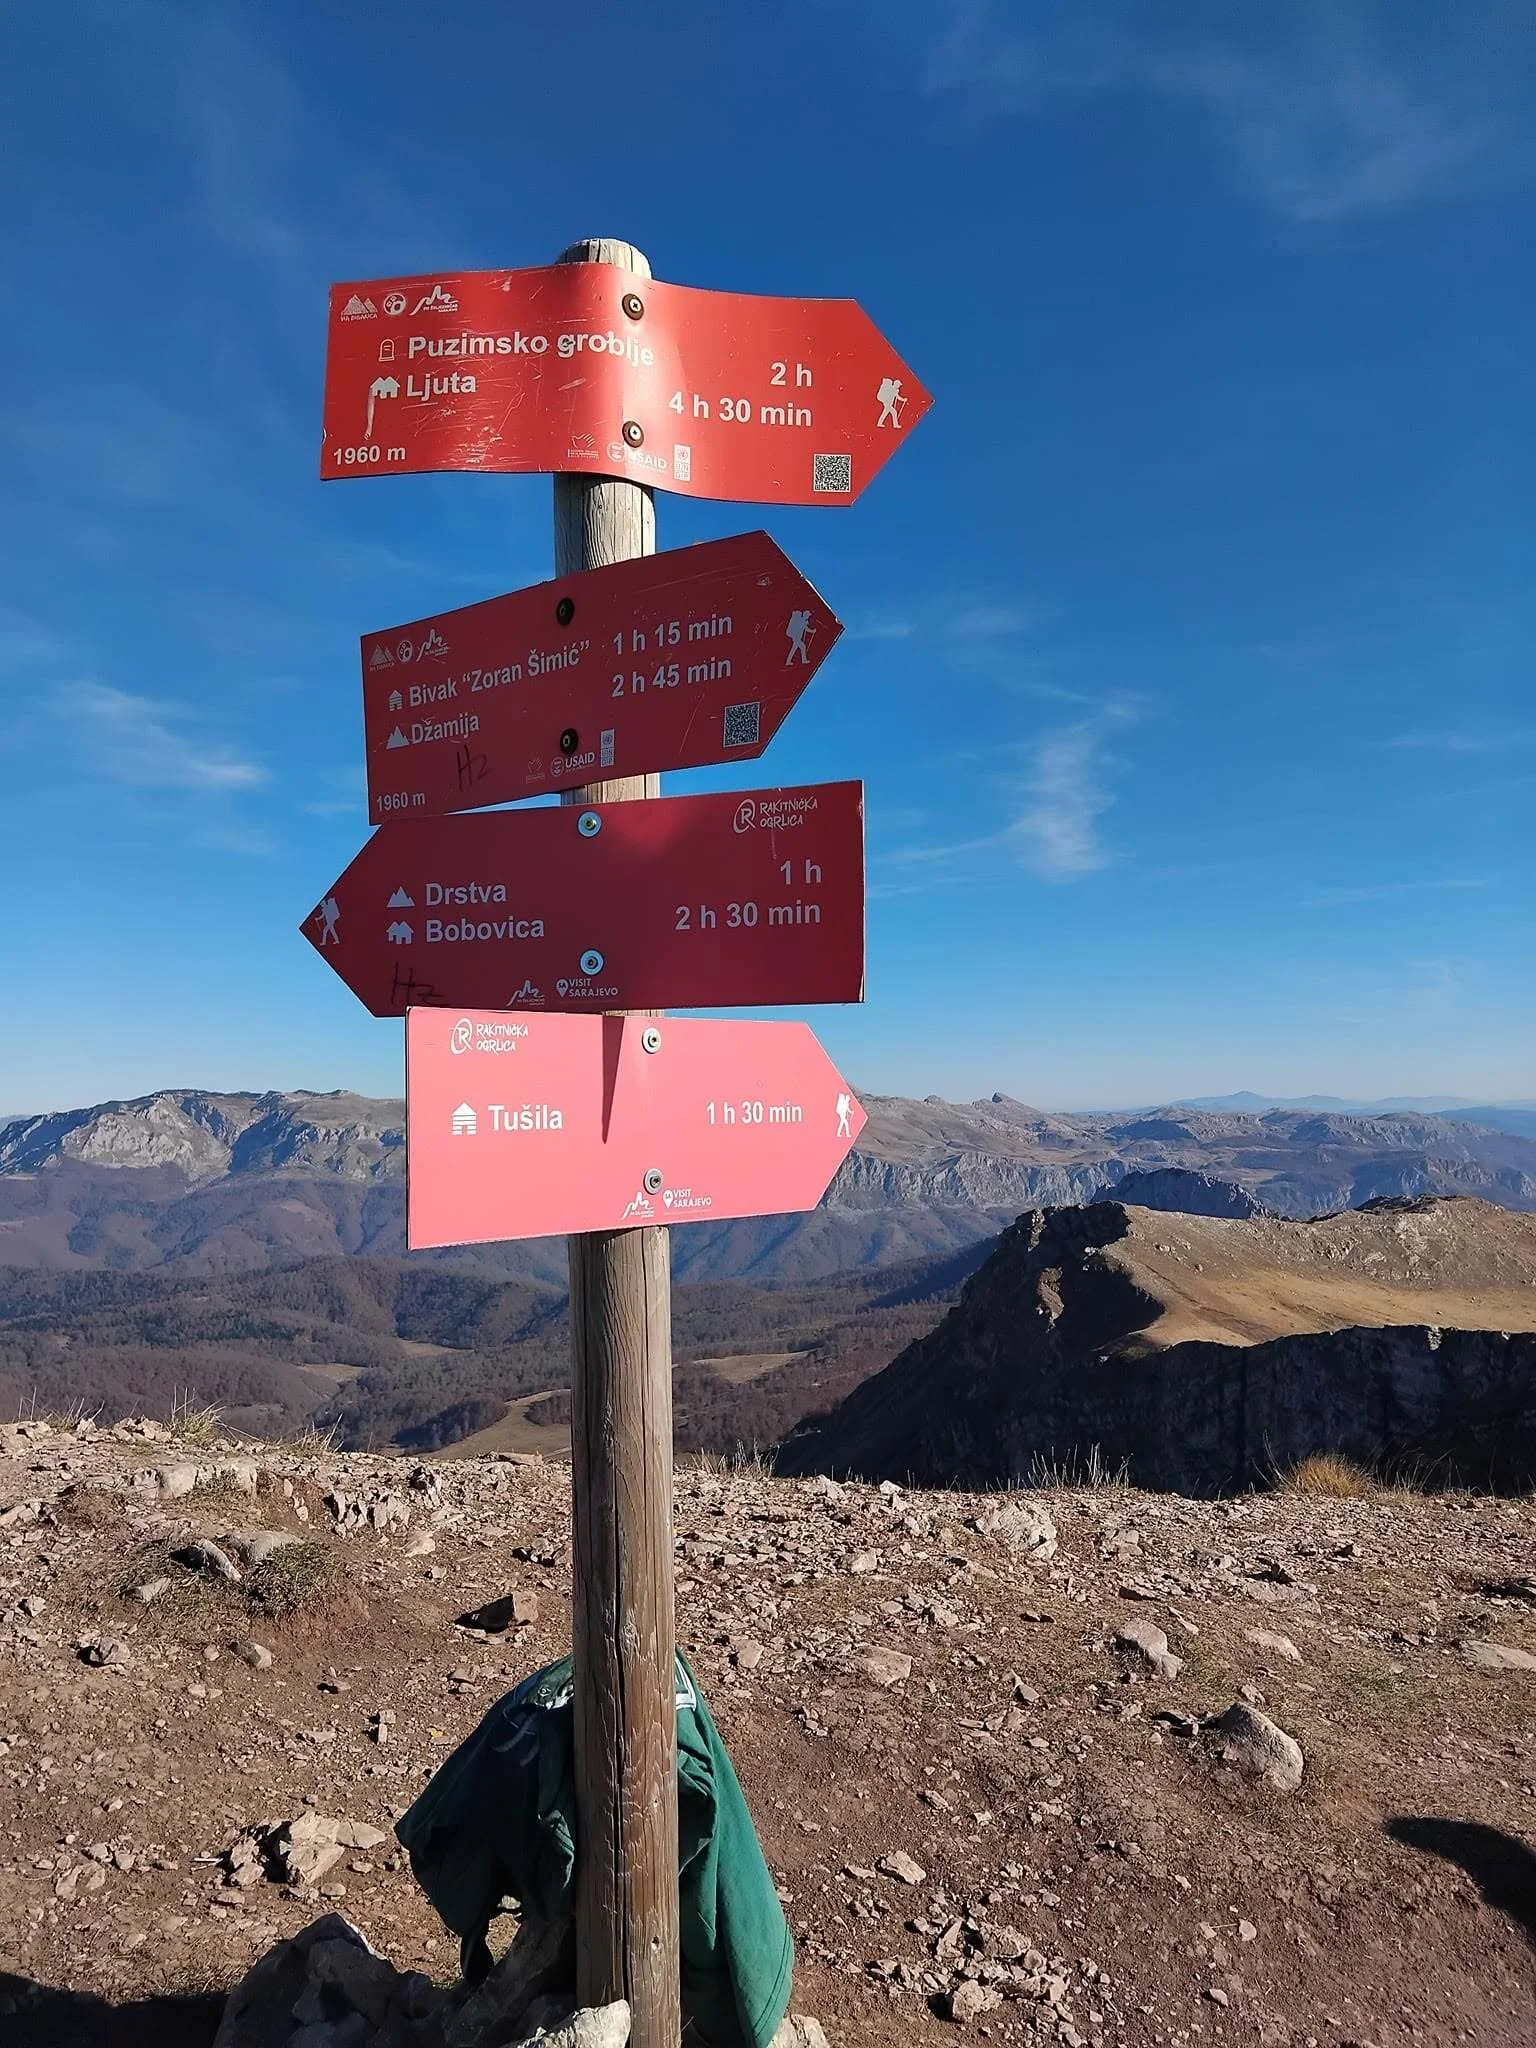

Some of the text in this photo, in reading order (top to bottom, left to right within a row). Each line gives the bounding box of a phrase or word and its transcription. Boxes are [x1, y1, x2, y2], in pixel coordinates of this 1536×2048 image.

[408, 330, 655, 367] Puzimsko groblje
[406, 372, 477, 401] Ljuta
[770, 362, 812, 387] 2 h
[669, 391, 812, 427] 4 h 30 min
[333, 446, 406, 465] 1960 m
[613, 614, 732, 655] 1 h 15 min
[612, 656, 731, 697] 2 h 45 min
[409, 678, 457, 707] Bivak
[411, 712, 479, 745] Džamija
[565, 751, 595, 769] USAID
[377, 792, 426, 812] 1960 m
[780, 859, 822, 884] 1 h
[426, 881, 507, 906] Drstva
[675, 899, 820, 930] 2 h 30 min
[426, 916, 545, 943] Bobovica
[569, 978, 591, 987] VISIT
[569, 987, 618, 997] SARAJEVO
[488, 1104, 563, 1131] Tušila
[706, 1101, 802, 1125] 1 h 30 min
[673, 1188, 691, 1198] VISIT
[673, 1197, 712, 1208] SARAJEVO
